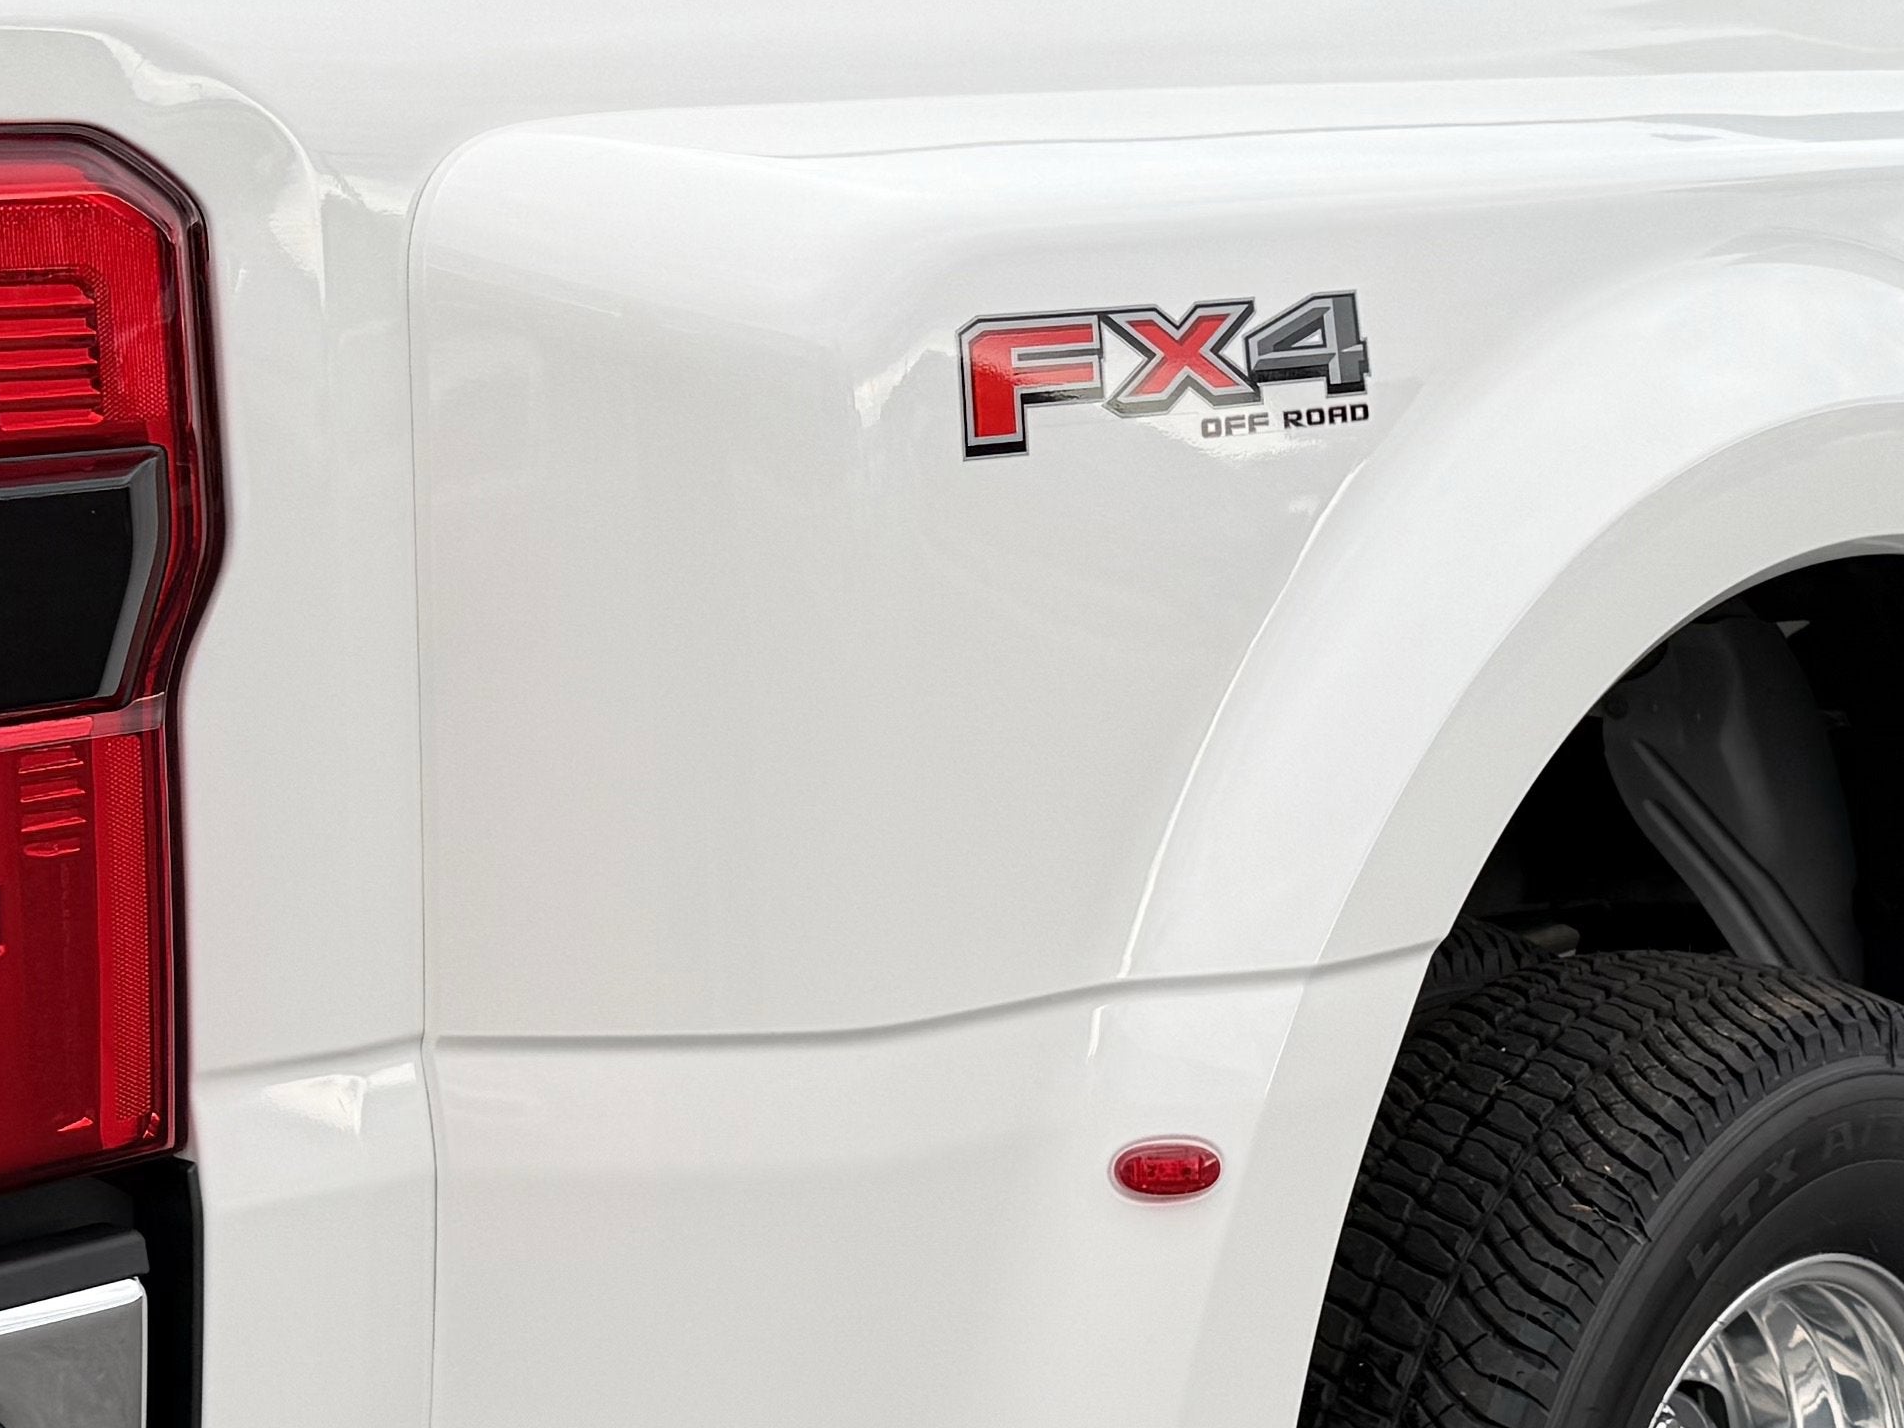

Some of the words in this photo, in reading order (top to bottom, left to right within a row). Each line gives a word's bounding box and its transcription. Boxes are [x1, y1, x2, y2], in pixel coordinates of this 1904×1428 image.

[955, 289, 1371, 461] FX4
[1200, 411, 1270, 439] OFF
[1283, 403, 1371, 429] ROAD
[1686, 1148, 1800, 1281] LTX
